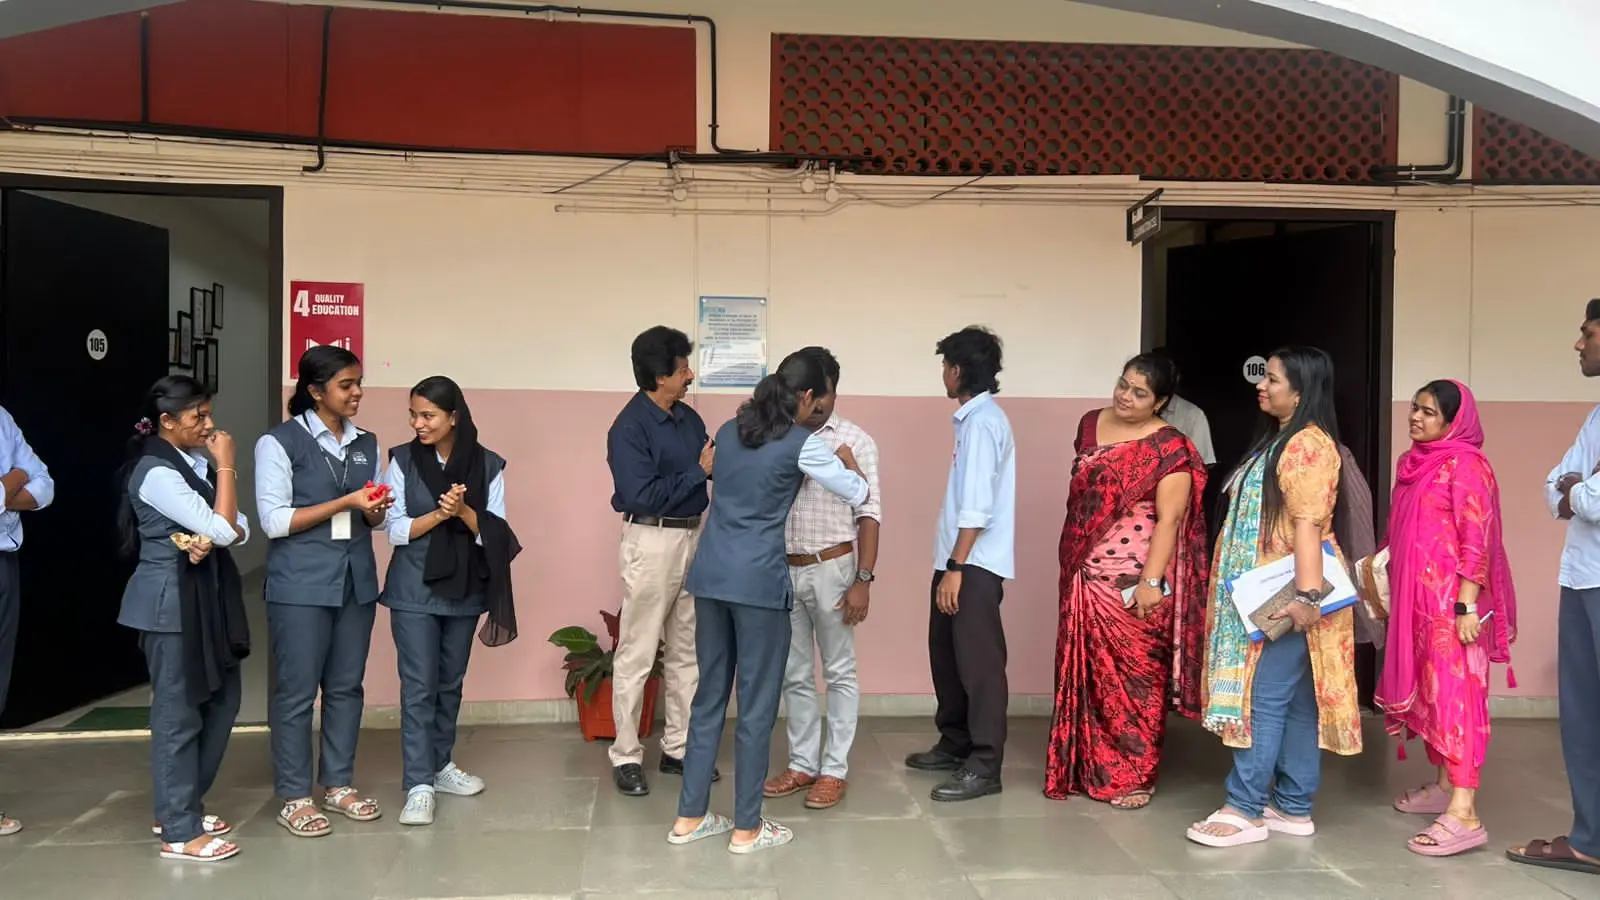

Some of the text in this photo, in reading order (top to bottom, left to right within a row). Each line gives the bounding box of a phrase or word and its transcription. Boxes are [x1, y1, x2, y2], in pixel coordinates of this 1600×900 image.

[293, 290, 310, 317] 4
[314, 294, 345, 304] QUALITY
[312, 304, 359, 316] EDUCATION
[89, 338, 105, 352] 105
[1246, 363, 1265, 376] 106
